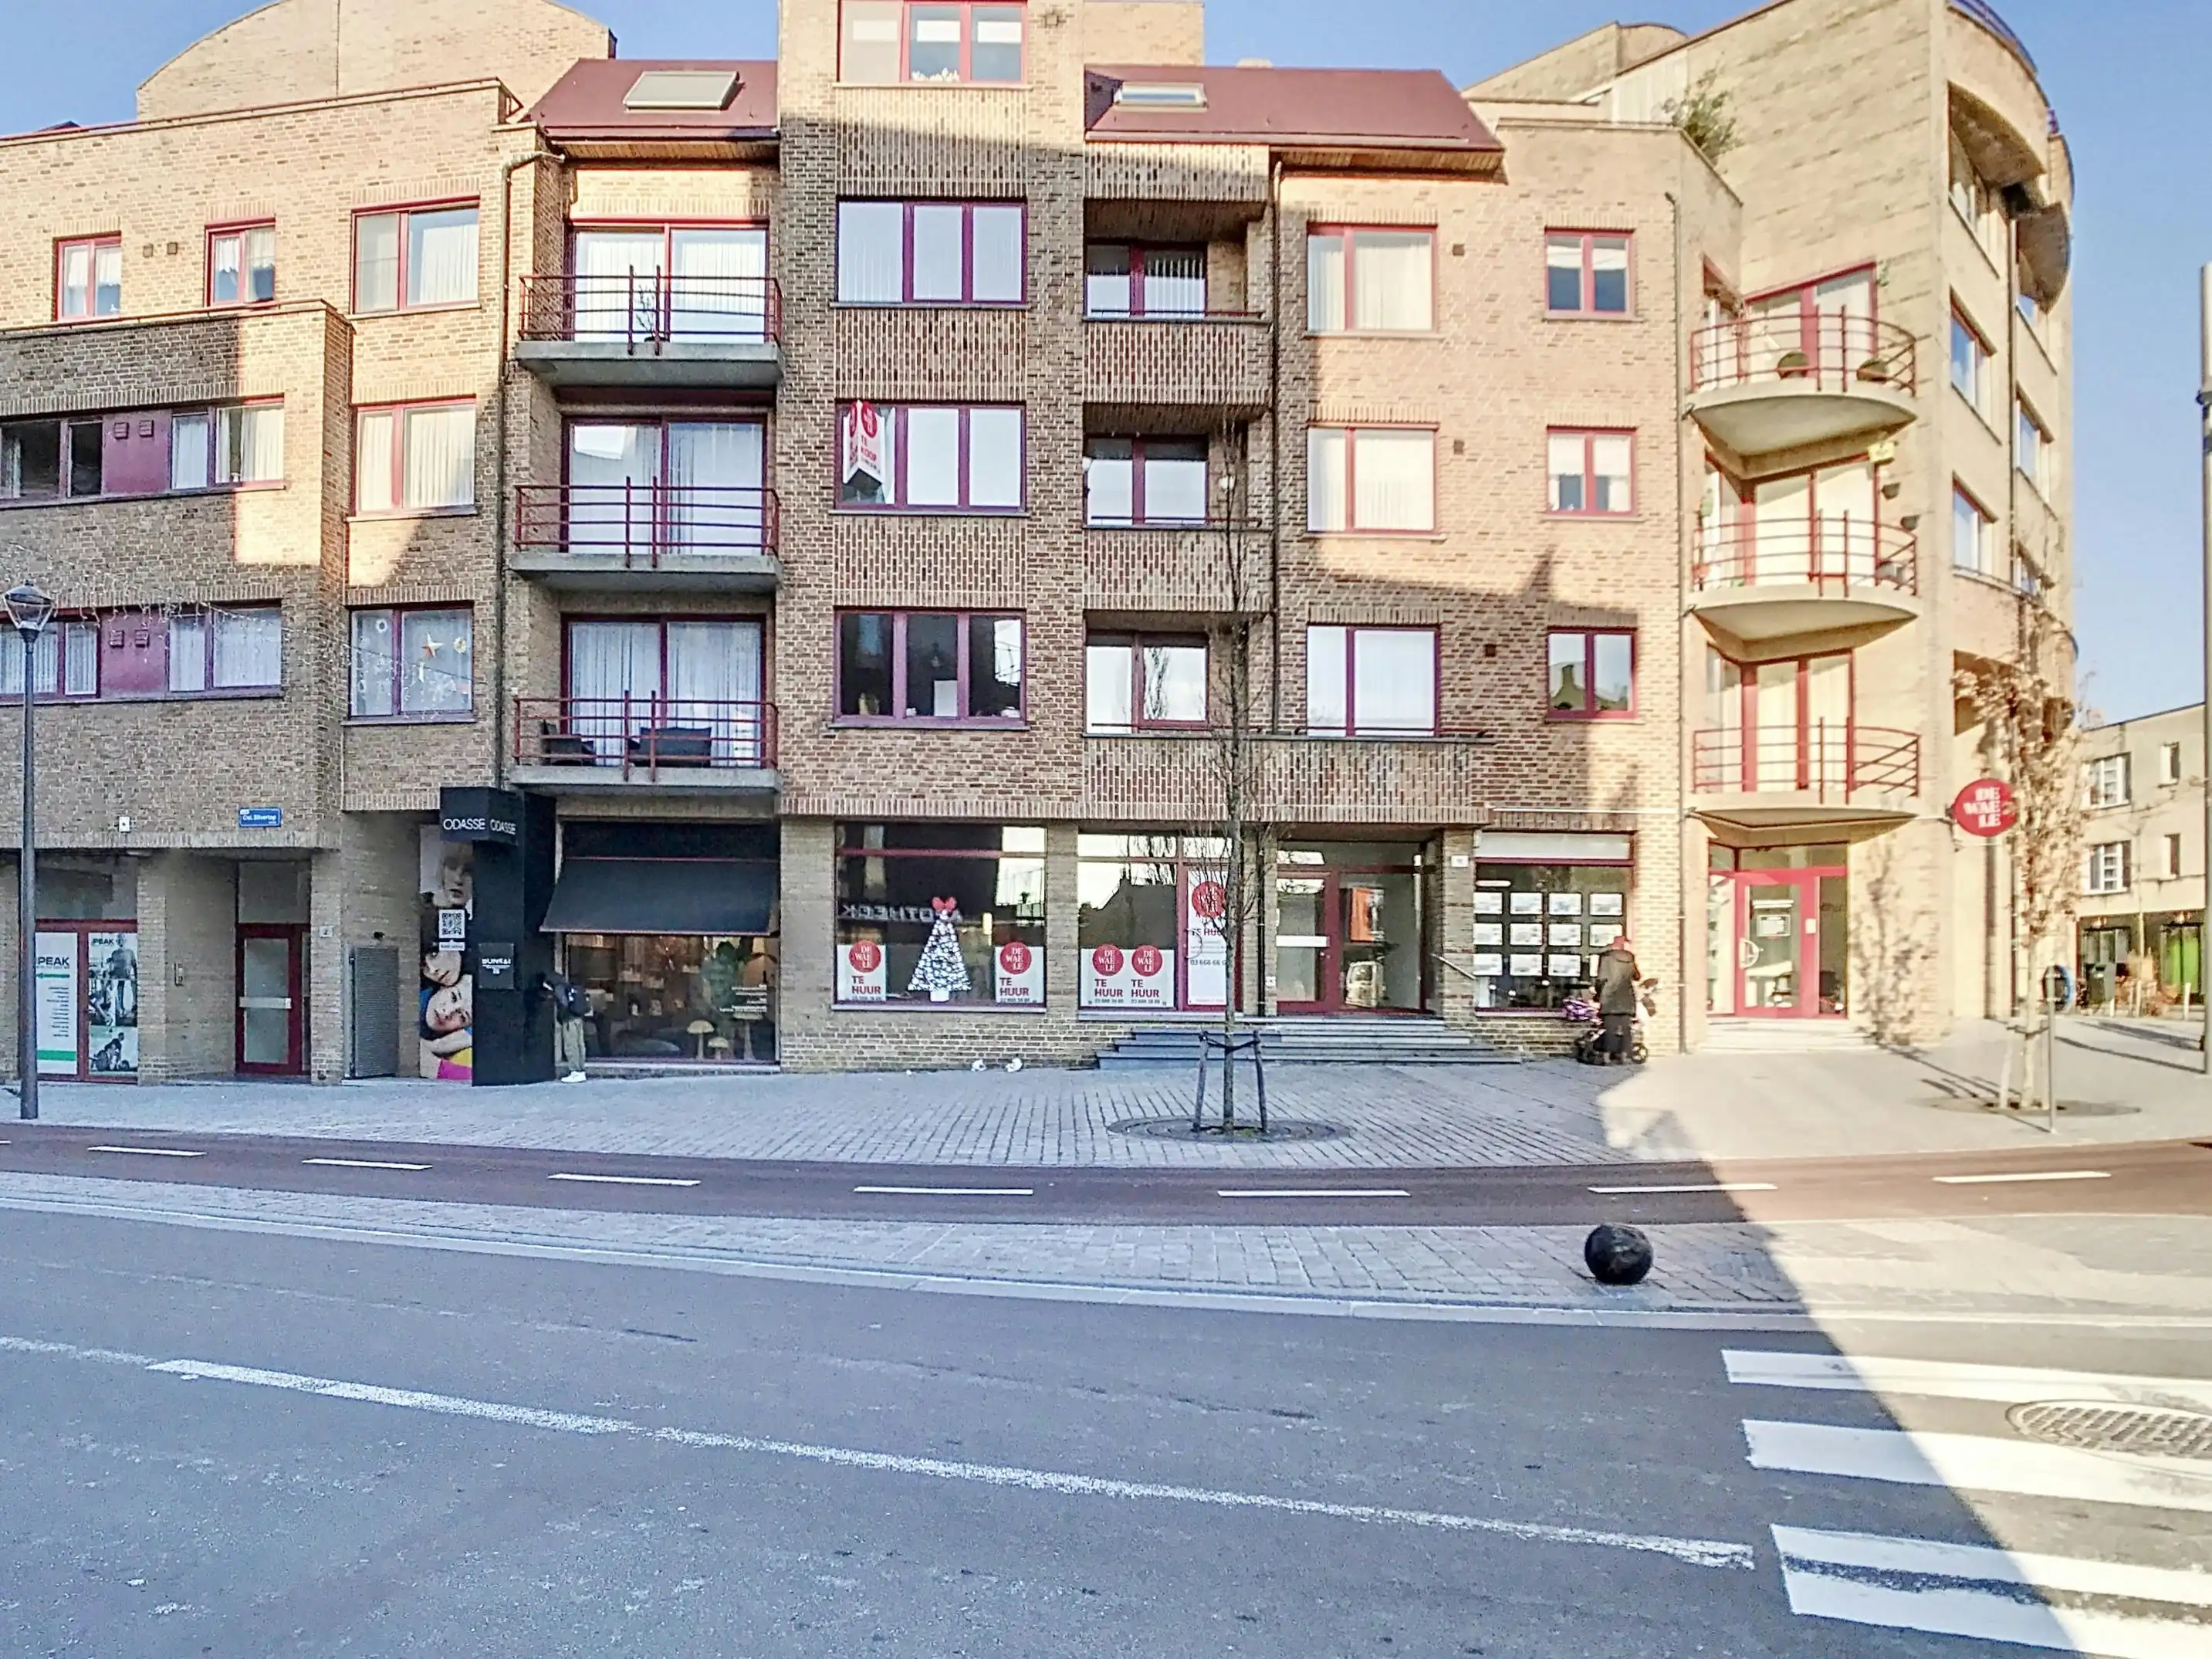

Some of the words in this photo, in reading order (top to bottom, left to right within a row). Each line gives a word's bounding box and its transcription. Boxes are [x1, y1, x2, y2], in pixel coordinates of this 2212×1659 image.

[1975, 787, 2001, 801] DE
[1963, 801, 2001, 814] WAE
[443, 818, 485, 830] ODASSE
[1978, 814, 2001, 828] LE
[490, 819, 516, 835] ODASSE
[38, 956, 69, 966] PEAK
[851, 975, 864, 984] TE
[999, 977, 1012, 986] TE
[1094, 978, 1107, 987] TE
[1131, 979, 1144, 987] TE
[851, 985, 881, 994] HUUR
[1094, 988, 1123, 997] HUUR
[1131, 989, 1159, 997] HUUR
